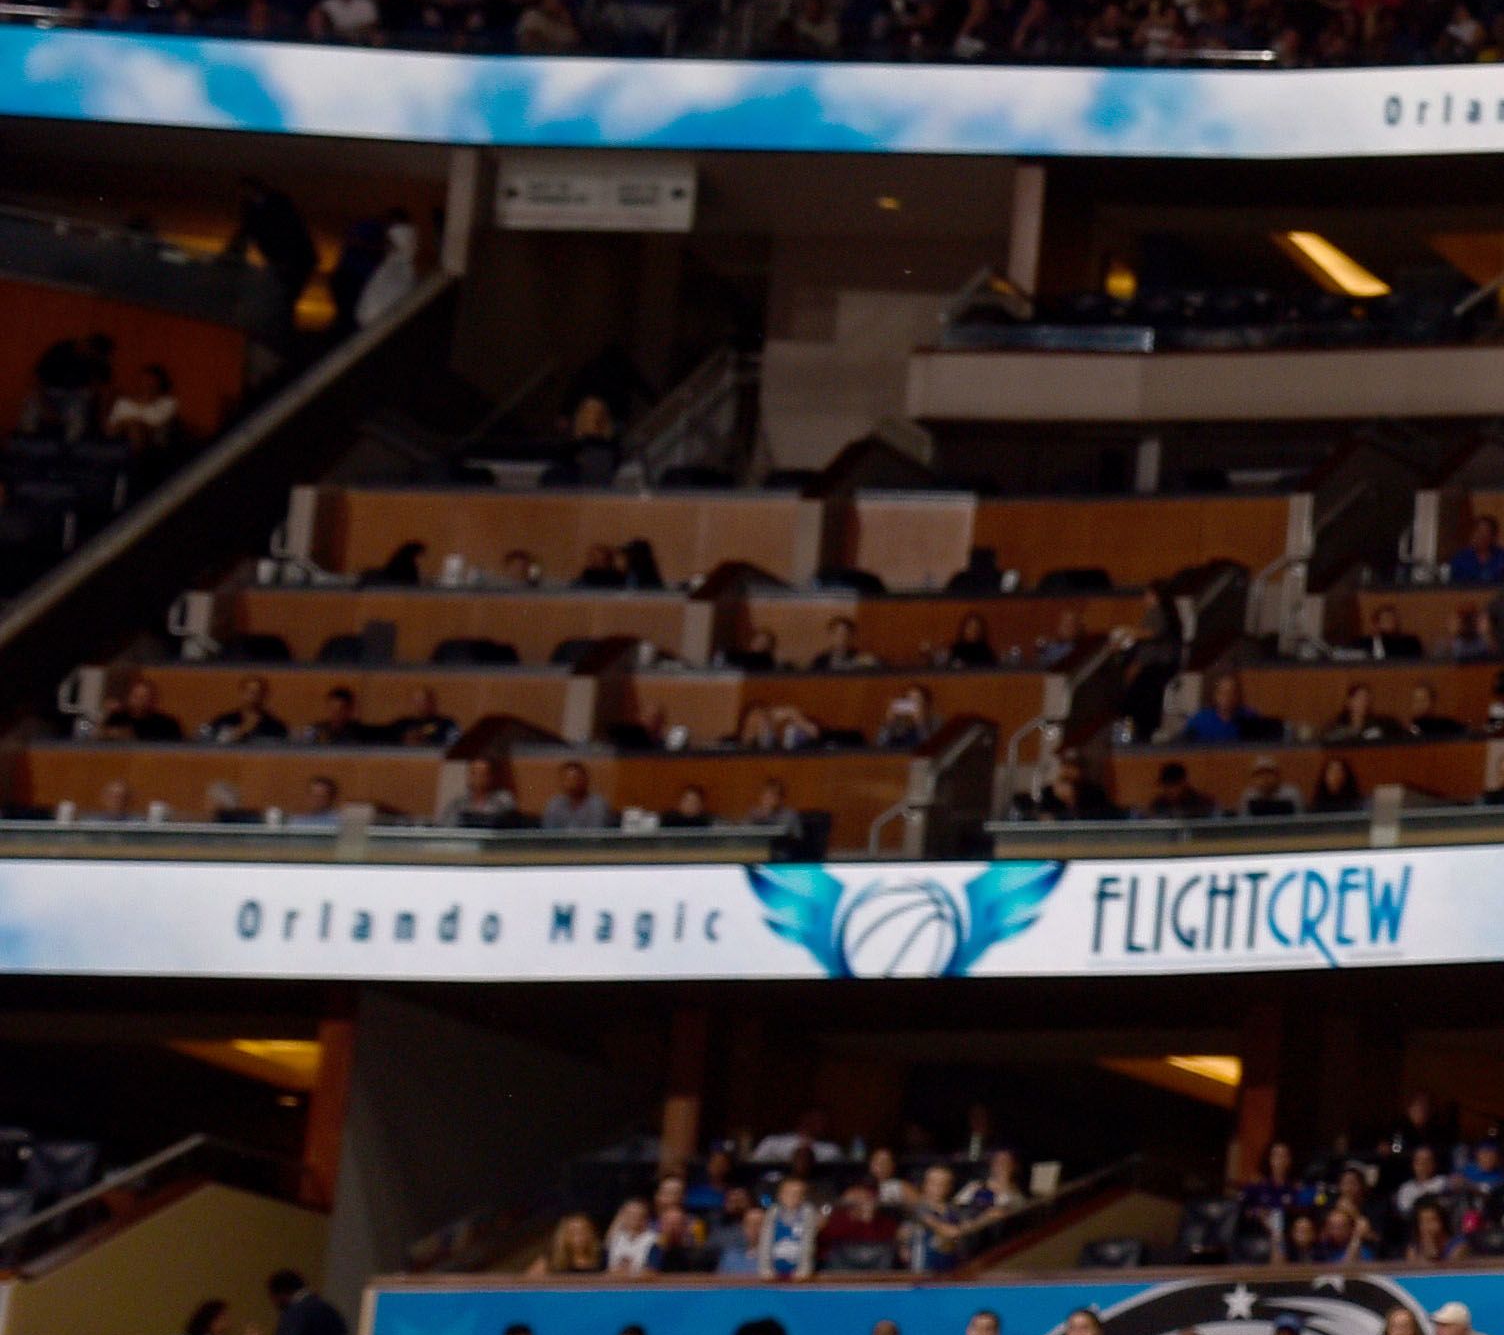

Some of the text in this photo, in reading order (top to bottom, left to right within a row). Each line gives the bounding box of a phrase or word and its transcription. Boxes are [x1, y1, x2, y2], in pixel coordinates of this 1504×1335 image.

[236, 900, 723, 950] Orlando Magic
[1092, 865, 1414, 970] FLIGHTCREW
